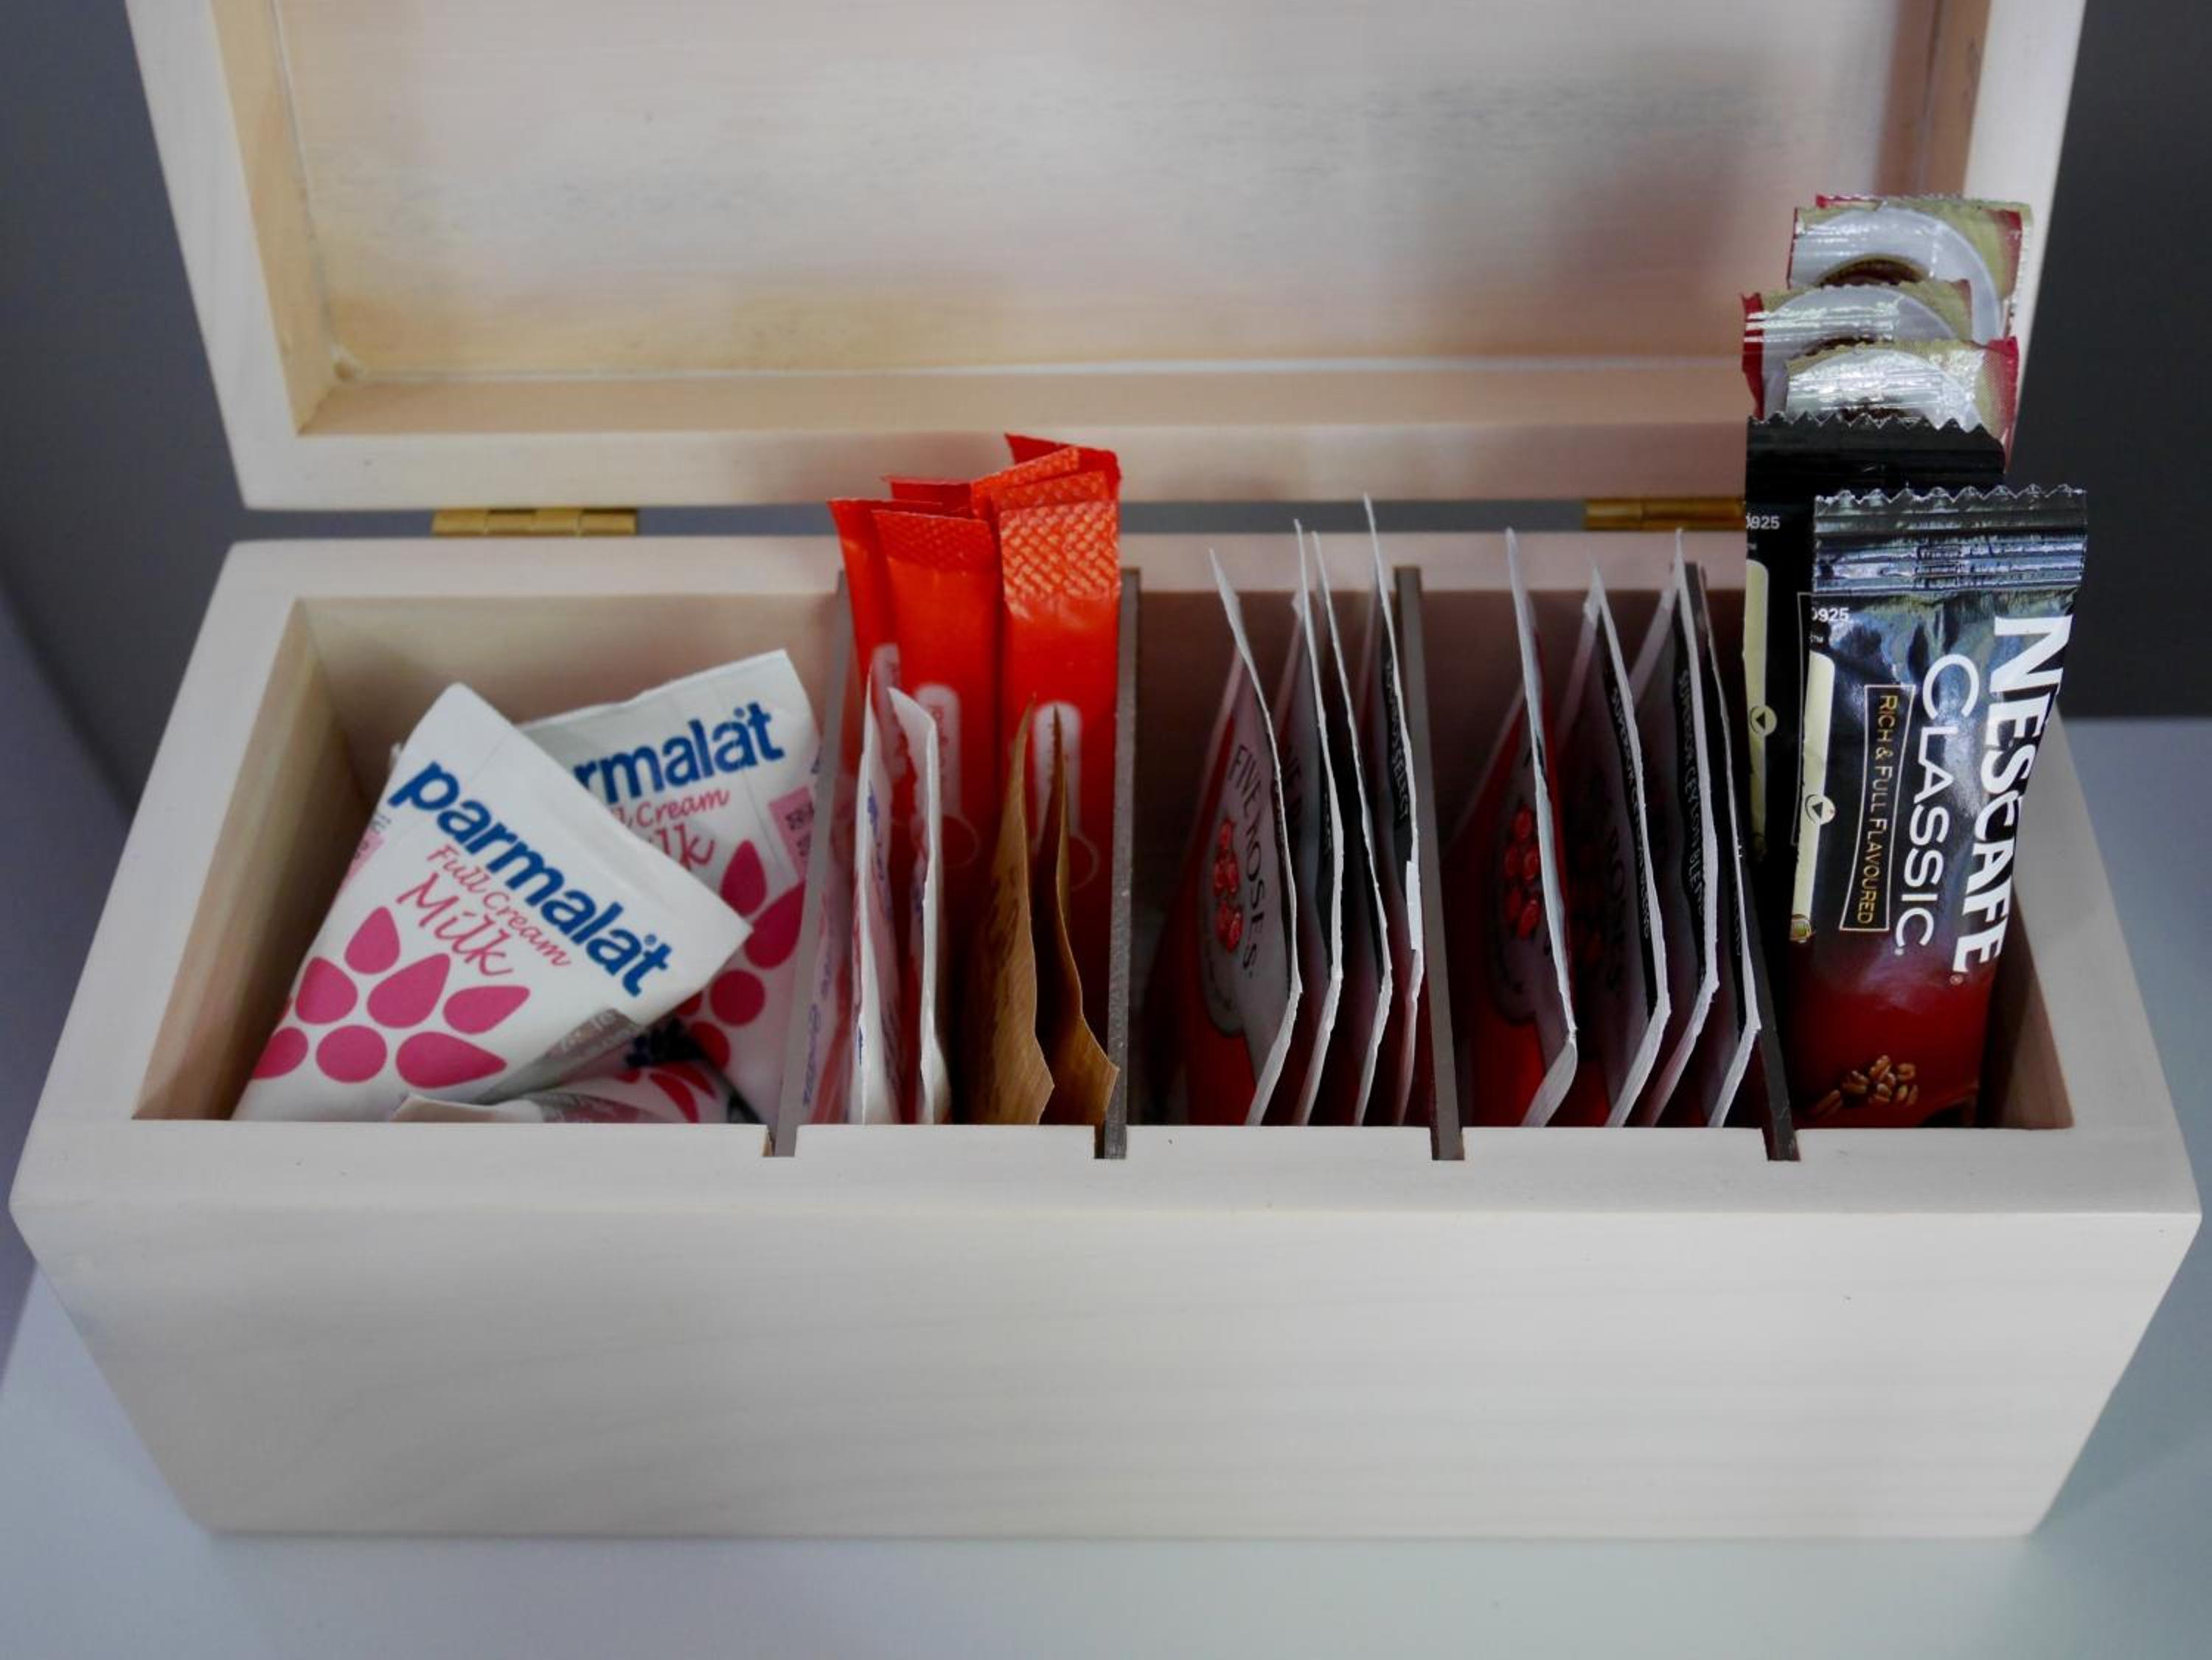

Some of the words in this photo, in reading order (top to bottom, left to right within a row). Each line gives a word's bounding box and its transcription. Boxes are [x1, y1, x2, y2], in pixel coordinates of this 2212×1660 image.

[573, 702, 785, 804] rmalat
[1875, 746, 1893, 761] &
[1877, 695, 1899, 742] RICH
[636, 788, 731, 828] Cream
[1871, 766, 1893, 810] FULL
[1896, 654, 1979, 947] CLASSIC
[388, 761, 672, 997] parmalat
[648, 822, 716, 871] lk
[1857, 818, 1888, 925] FLAVOURED
[396, 872, 514, 977] Milk
[427, 843, 492, 894] Full
[483, 890, 571, 969] Cream
